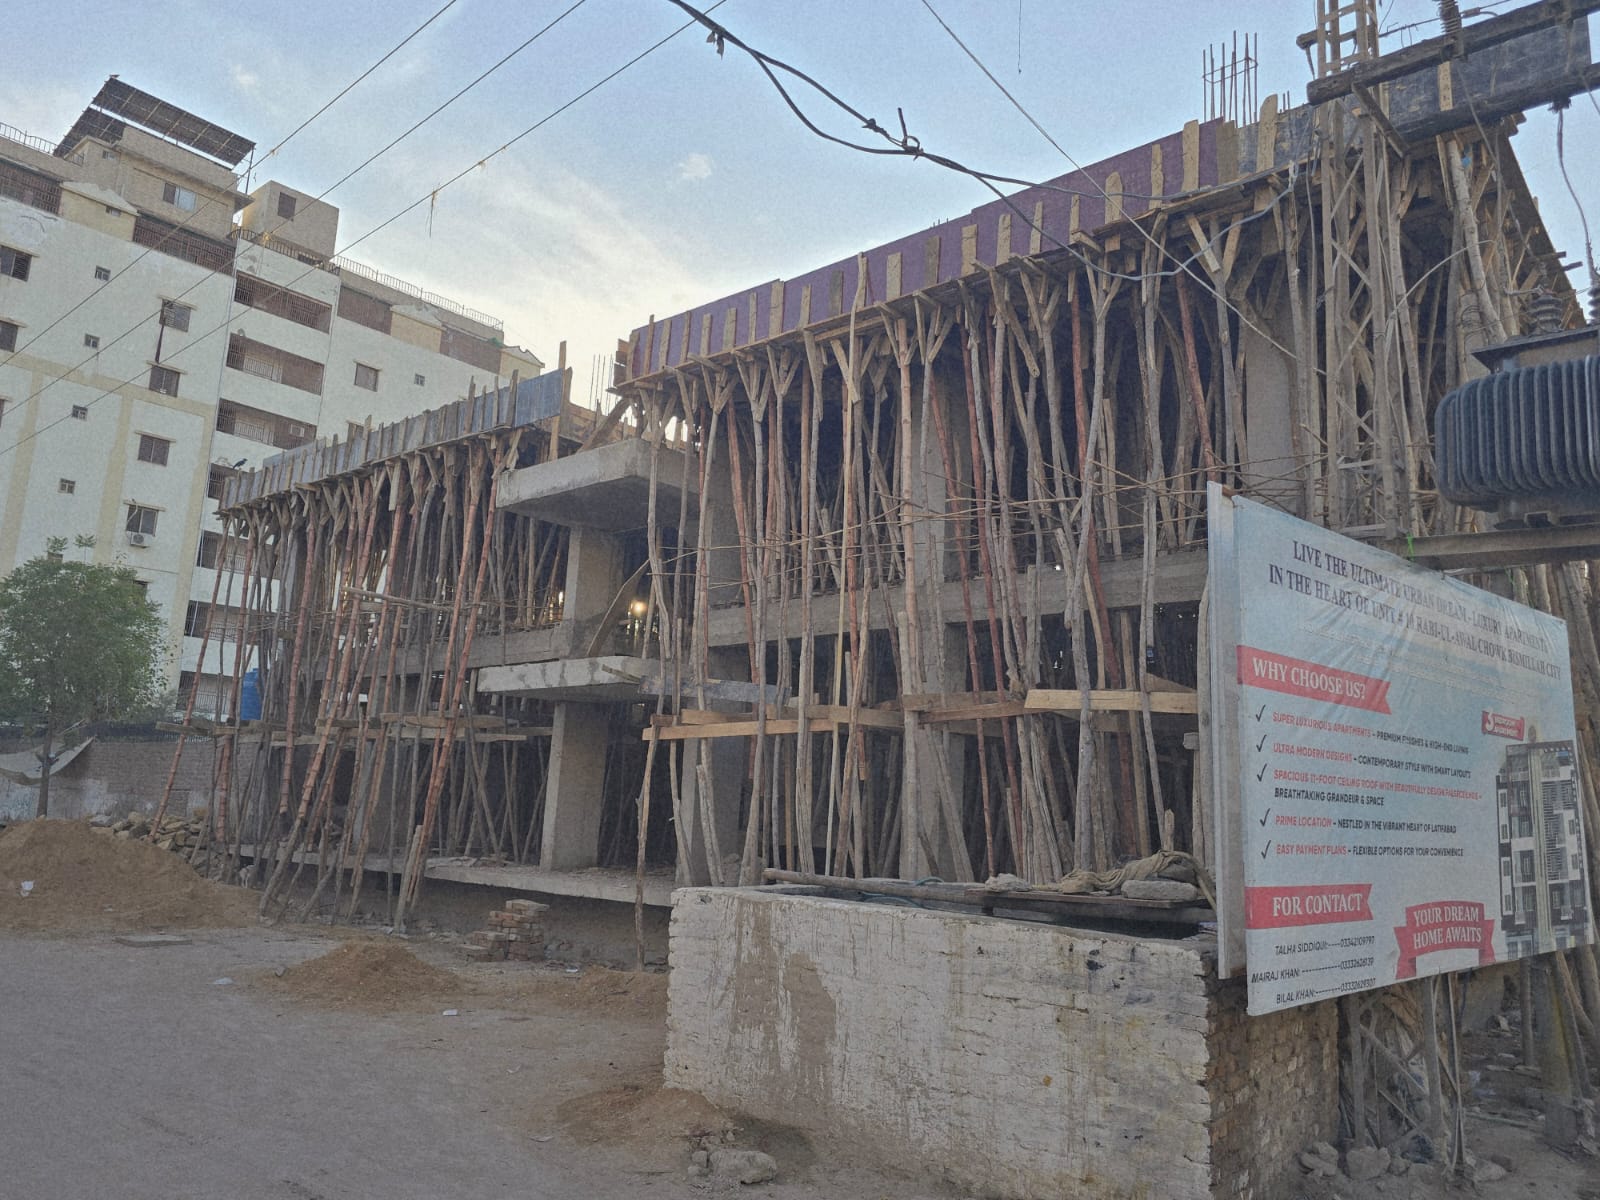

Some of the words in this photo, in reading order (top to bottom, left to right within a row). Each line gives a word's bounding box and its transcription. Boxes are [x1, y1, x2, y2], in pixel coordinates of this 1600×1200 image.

[1293, 540, 1321, 568] LIVE
[1325, 553, 1348, 578] THE
[1351, 563, 1401, 598] ULTIMATE
[1403, 583, 1435, 610] URBAN
[1269, 563, 1283, 586] IN
[1286, 569, 1311, 596] THE
[1315, 579, 1353, 610] HEART
[1355, 594, 1369, 615] OF
[1252, 656, 1288, 682] WHY
[1291, 666, 1344, 695] CHOOSE
[1345, 679, 1367, 700] US?
[1273, 711, 1295, 724] SUPER
[1333, 722, 1372, 738] APARTMENTS
[1274, 742, 1295, 755] ULTRA
[1296, 745, 1325, 759] MODERN
[1358, 754, 1404, 771] CONTEMPORARY
[1404, 761, 1420, 772] STYLE
[1421, 763, 1434, 774] WITH
[1274, 769, 1309, 783] SPACIOUS
[1275, 787, 1326, 801] BREATHTAKING
[1326, 792, 1359, 804] GRANDEUR
[1366, 796, 1384, 806] SPACE
[1275, 815, 1297, 826] PRIME
[1298, 817, 1332, 828] LOCATION
[1337, 819, 1363, 829] NESTLED
[1371, 820, 1383, 830] THE
[1276, 844, 1294, 855] EASY
[1296, 844, 1326, 855] PAYMENT
[1326, 845, 1347, 855] PLANS
[1352, 846, 1378, 856] FLEXIBLE
[1379, 846, 1403, 856] OPTIONS
[1403, 847, 1414, 856] FOR
[1415, 847, 1429, 857] YOUR
[1272, 896, 1302, 917] FOR
[1305, 893, 1363, 915] CONTACT
[1413, 906, 1443, 927] YOUR
[1444, 905, 1480, 923] DREAM
[1413, 927, 1444, 950] HOME
[1446, 926, 1482, 944] AWAITS
[1275, 944, 1296, 956] TALHA
[1251, 970, 1279, 984] MAIRAJ
[1276, 992, 1295, 1004] BILAL
